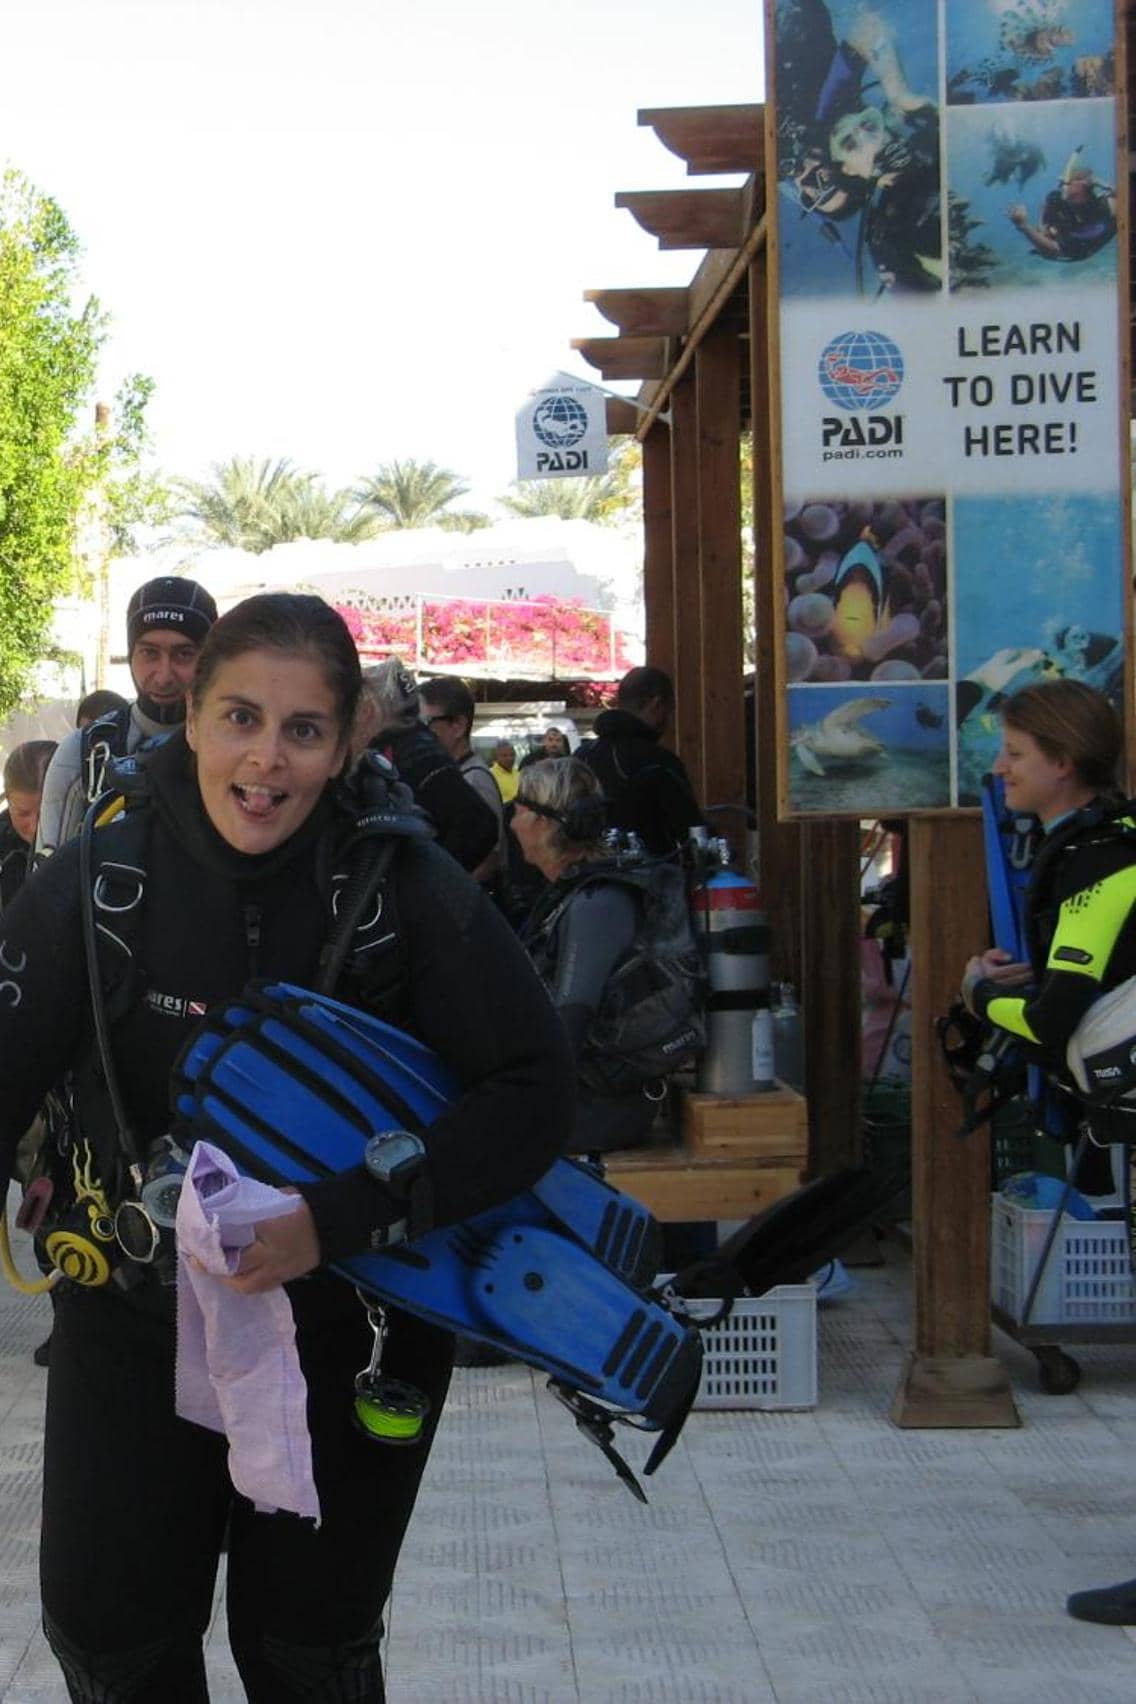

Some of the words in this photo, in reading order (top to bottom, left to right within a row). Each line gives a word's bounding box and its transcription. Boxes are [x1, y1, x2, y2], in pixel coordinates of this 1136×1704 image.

[958, 321, 1080, 357] LEARN
[943, 374, 993, 407] TO
[1011, 371, 1097, 405] DIVE
[822, 415, 903, 447] PADI
[965, 422, 1077, 457] HERE!
[536, 450, 588, 472] PADI
[822, 448, 903, 463] padi.com
[144, 610, 184, 623] mares
